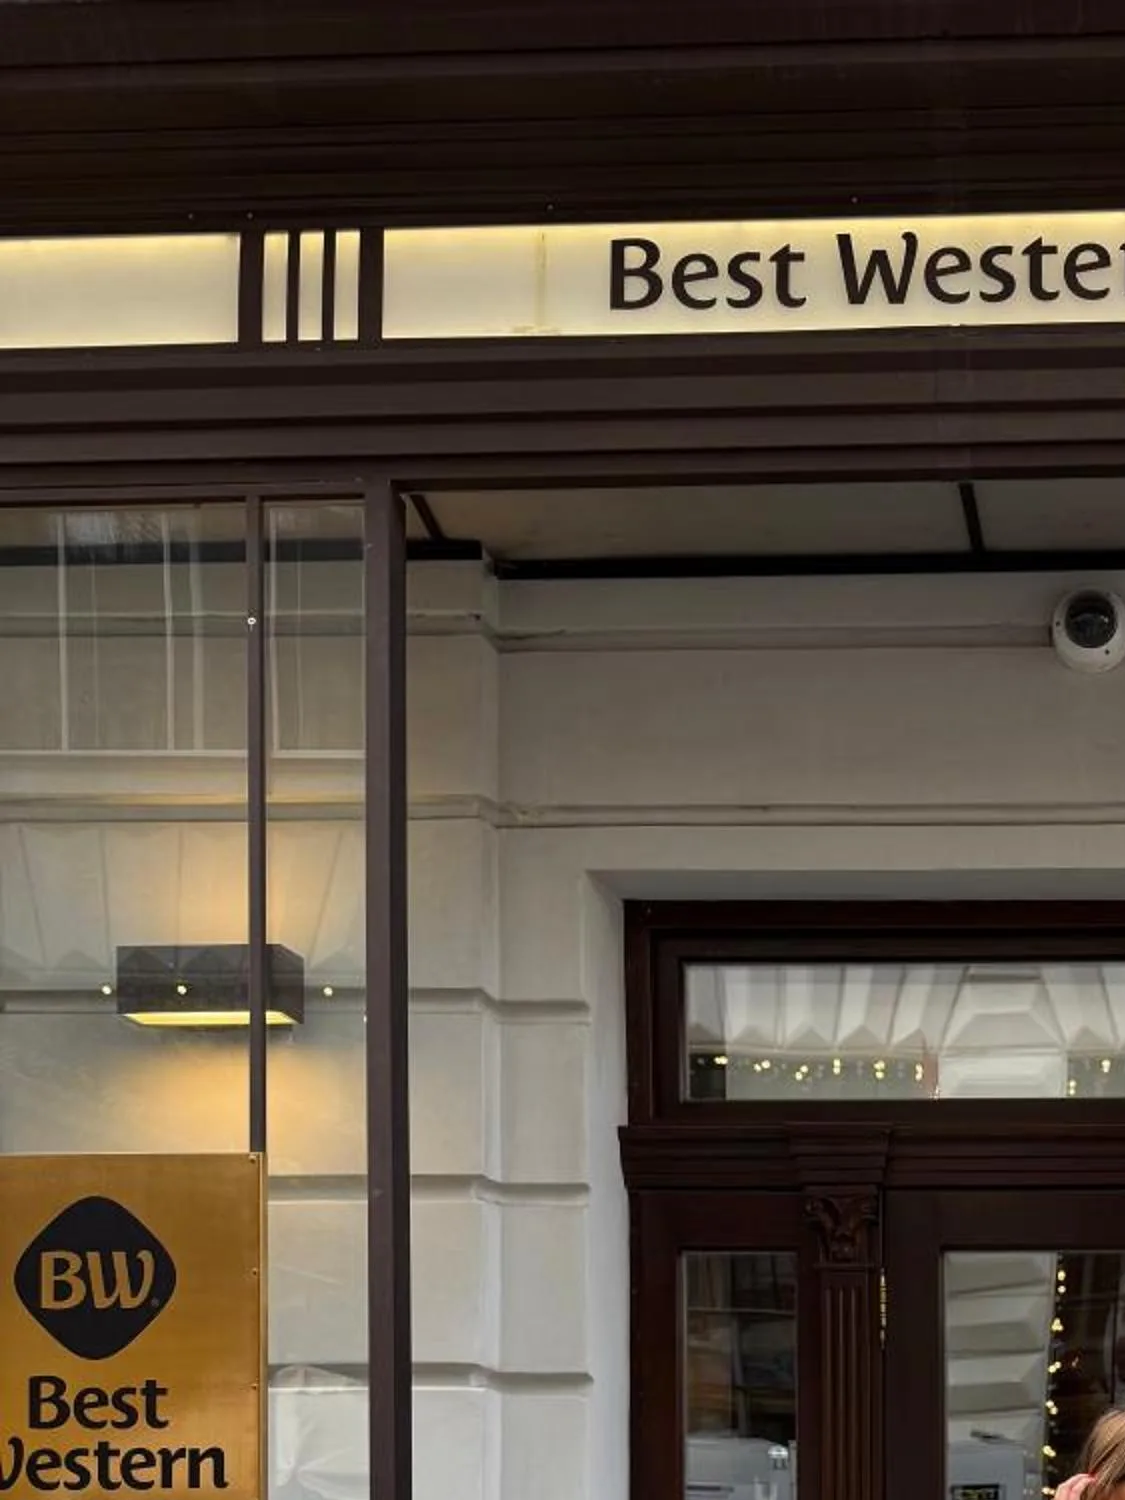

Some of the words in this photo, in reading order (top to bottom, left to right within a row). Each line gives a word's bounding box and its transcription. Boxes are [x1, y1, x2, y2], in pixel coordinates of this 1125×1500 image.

[609, 237, 807, 311] Best
[40, 1250, 155, 1311] BW
[28, 1375, 170, 1430] Best
